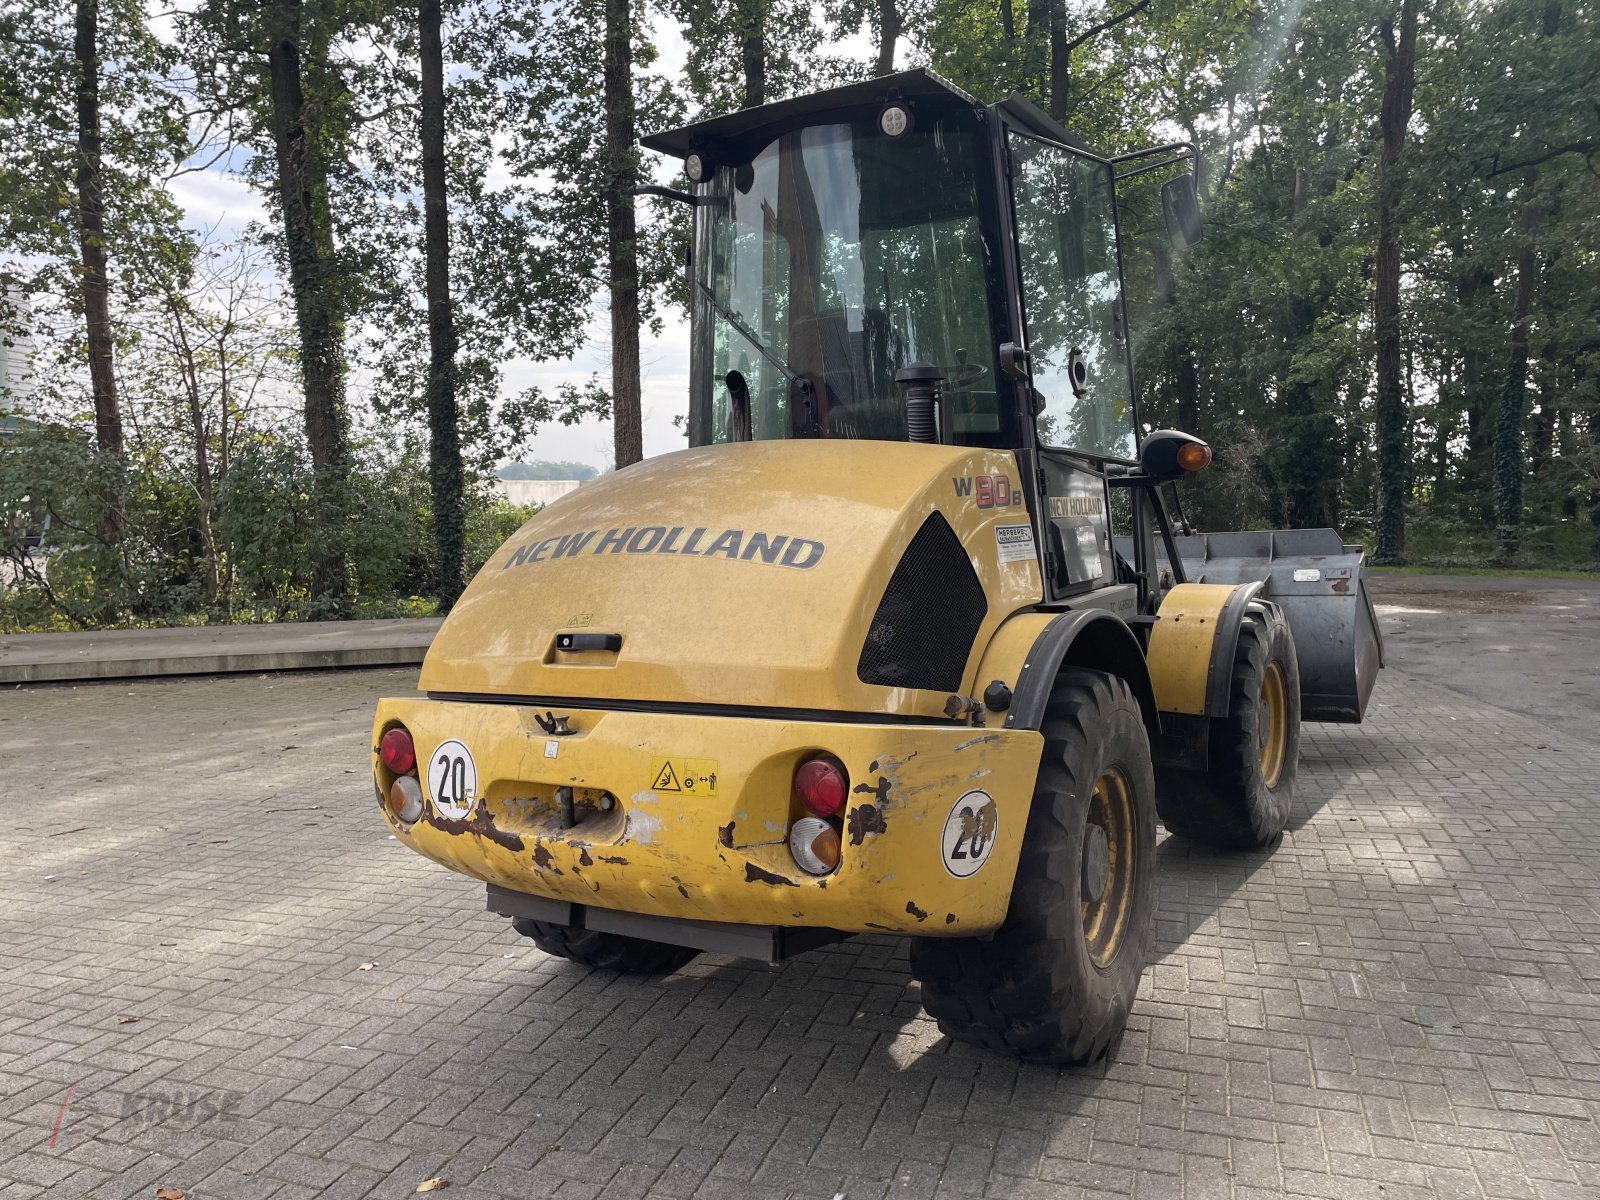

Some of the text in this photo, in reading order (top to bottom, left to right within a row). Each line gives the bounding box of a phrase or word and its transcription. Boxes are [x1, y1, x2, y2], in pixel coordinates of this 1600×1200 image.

[1050, 498, 1102, 517] NEW HOLLAND
[503, 526, 826, 571] NEW HOLLAND
[438, 754, 466, 804] 20
[951, 806, 989, 859] 20
